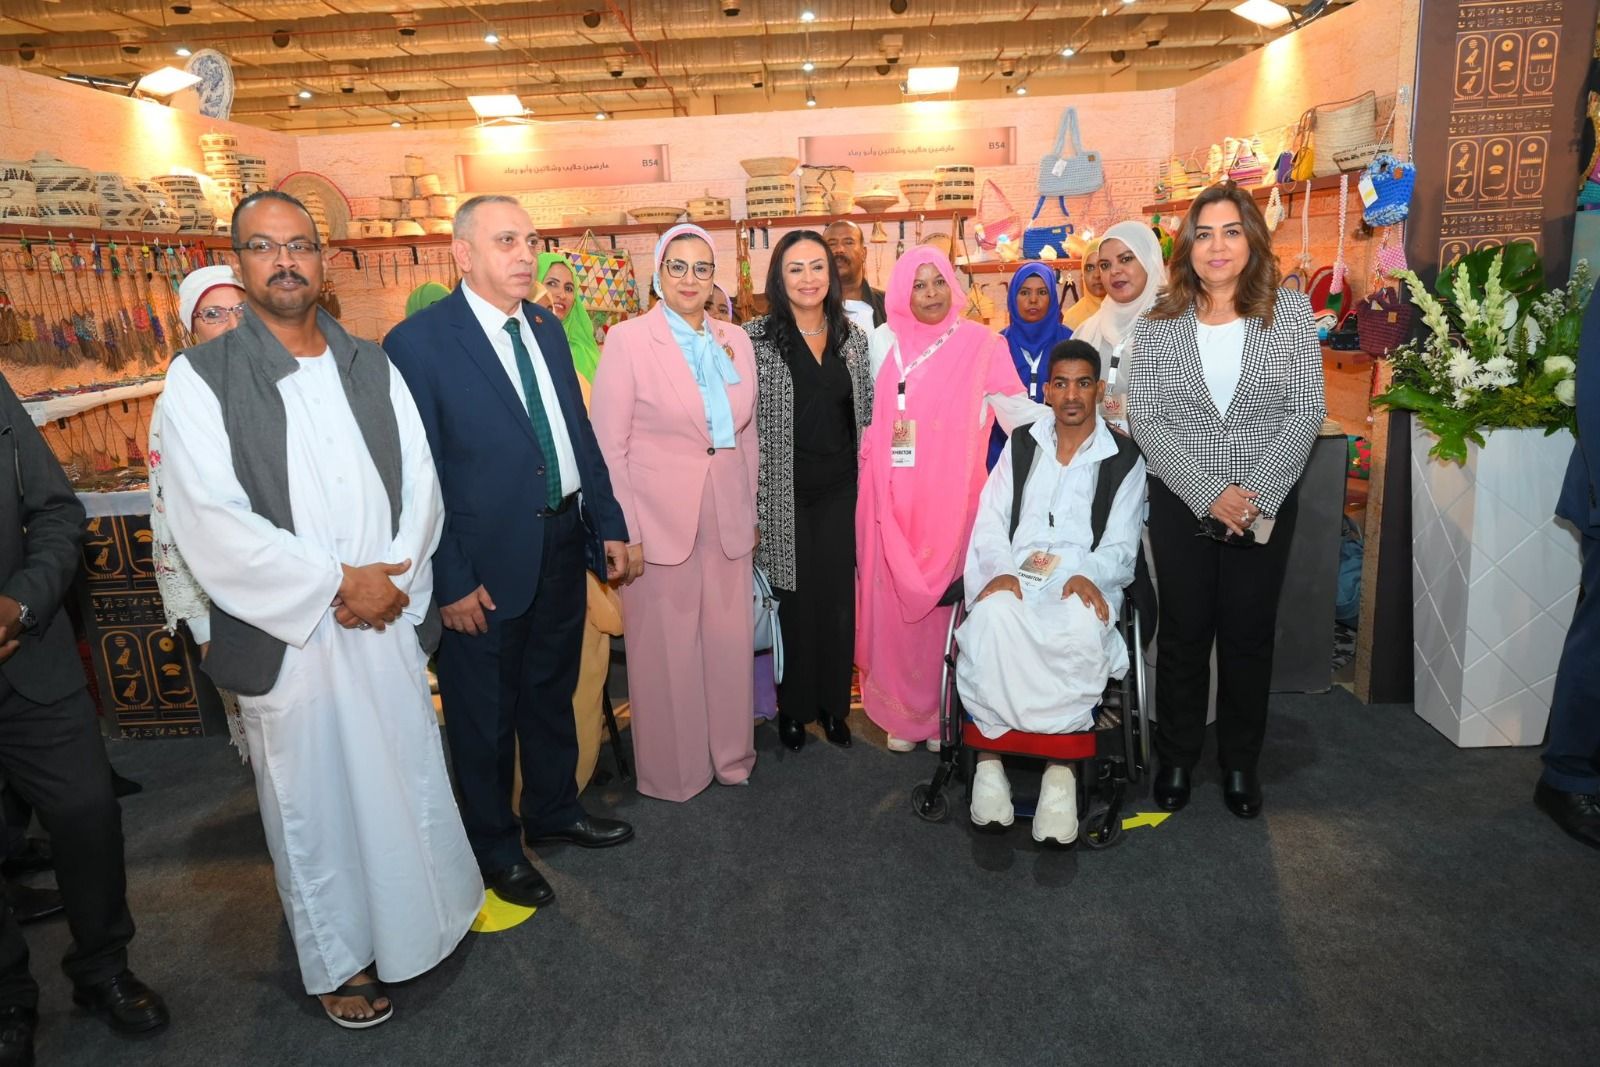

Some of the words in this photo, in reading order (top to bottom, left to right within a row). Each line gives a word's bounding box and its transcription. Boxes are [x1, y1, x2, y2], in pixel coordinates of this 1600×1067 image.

[907, 145, 926, 155] حلايب
[988, 141, 1006, 150] B54
[878, 147, 906, 157] وشلاتين
[562, 163, 581, 173] حلايب
[642, 159, 659, 168] B54
[534, 164, 561, 174] وشلاتين
